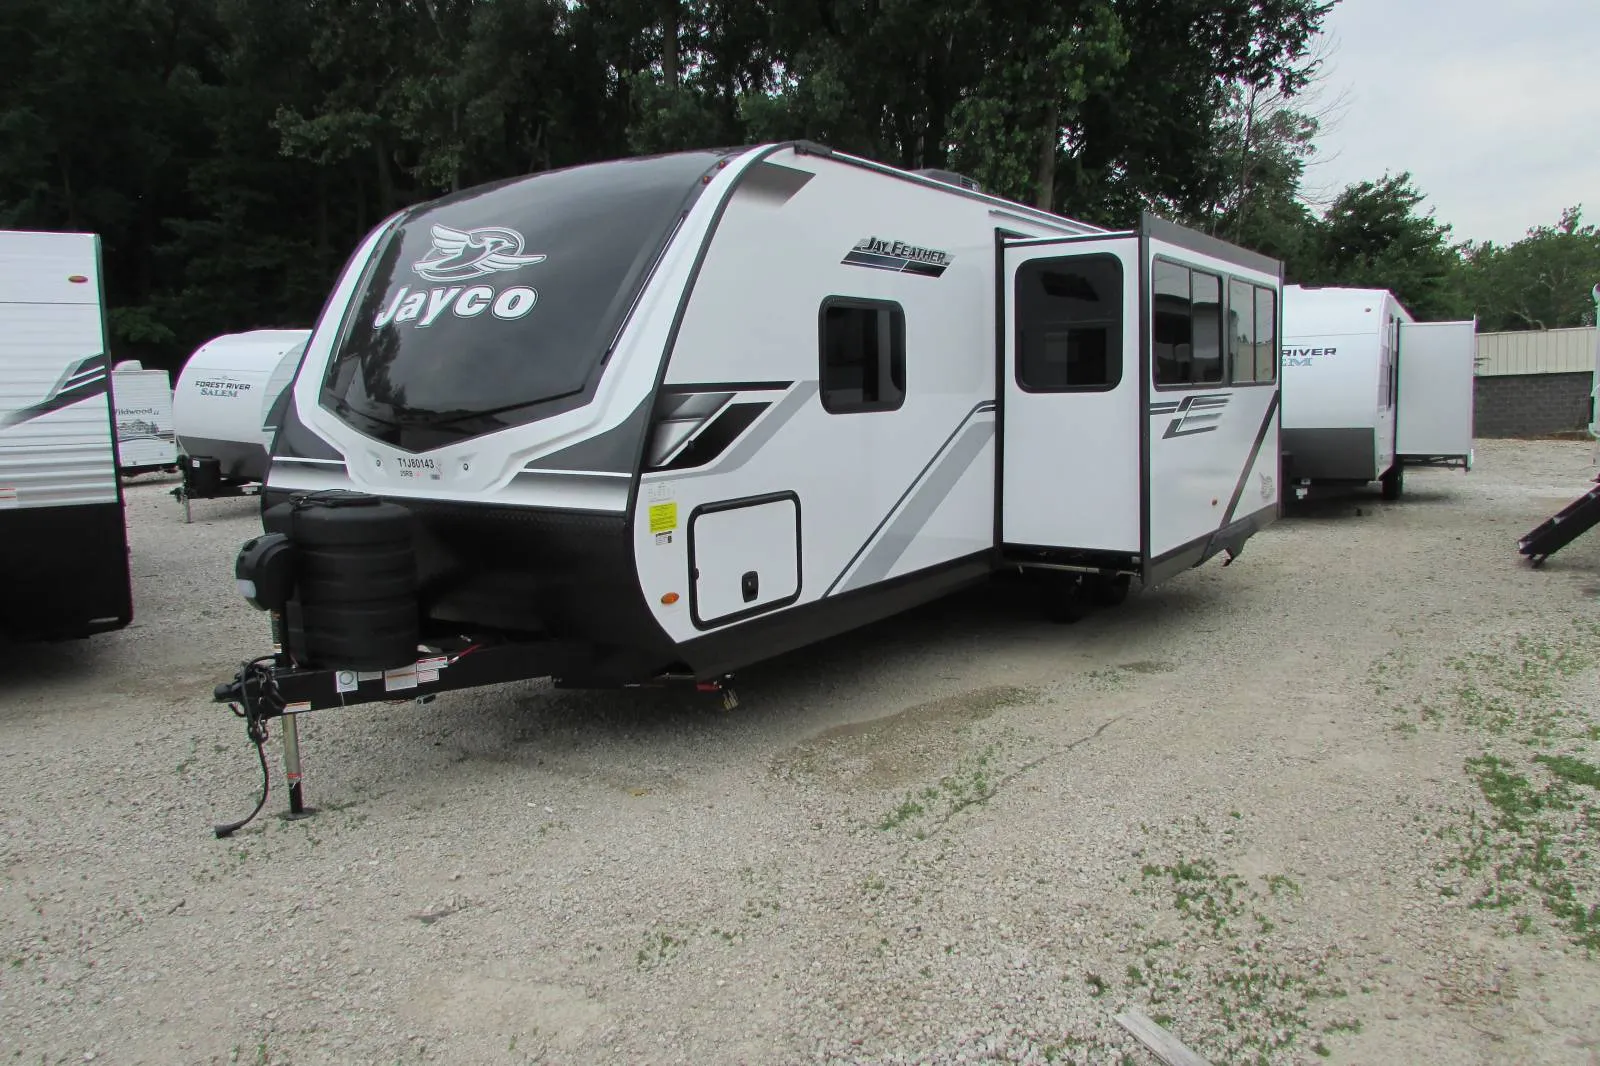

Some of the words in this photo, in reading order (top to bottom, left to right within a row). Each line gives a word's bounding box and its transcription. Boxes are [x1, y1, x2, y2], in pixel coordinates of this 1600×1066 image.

[373, 285, 538, 329] Jayco
[195, 380, 226, 389] FOREST
[226, 382, 251, 390] RIVER
[200, 387, 239, 398] SALEM
